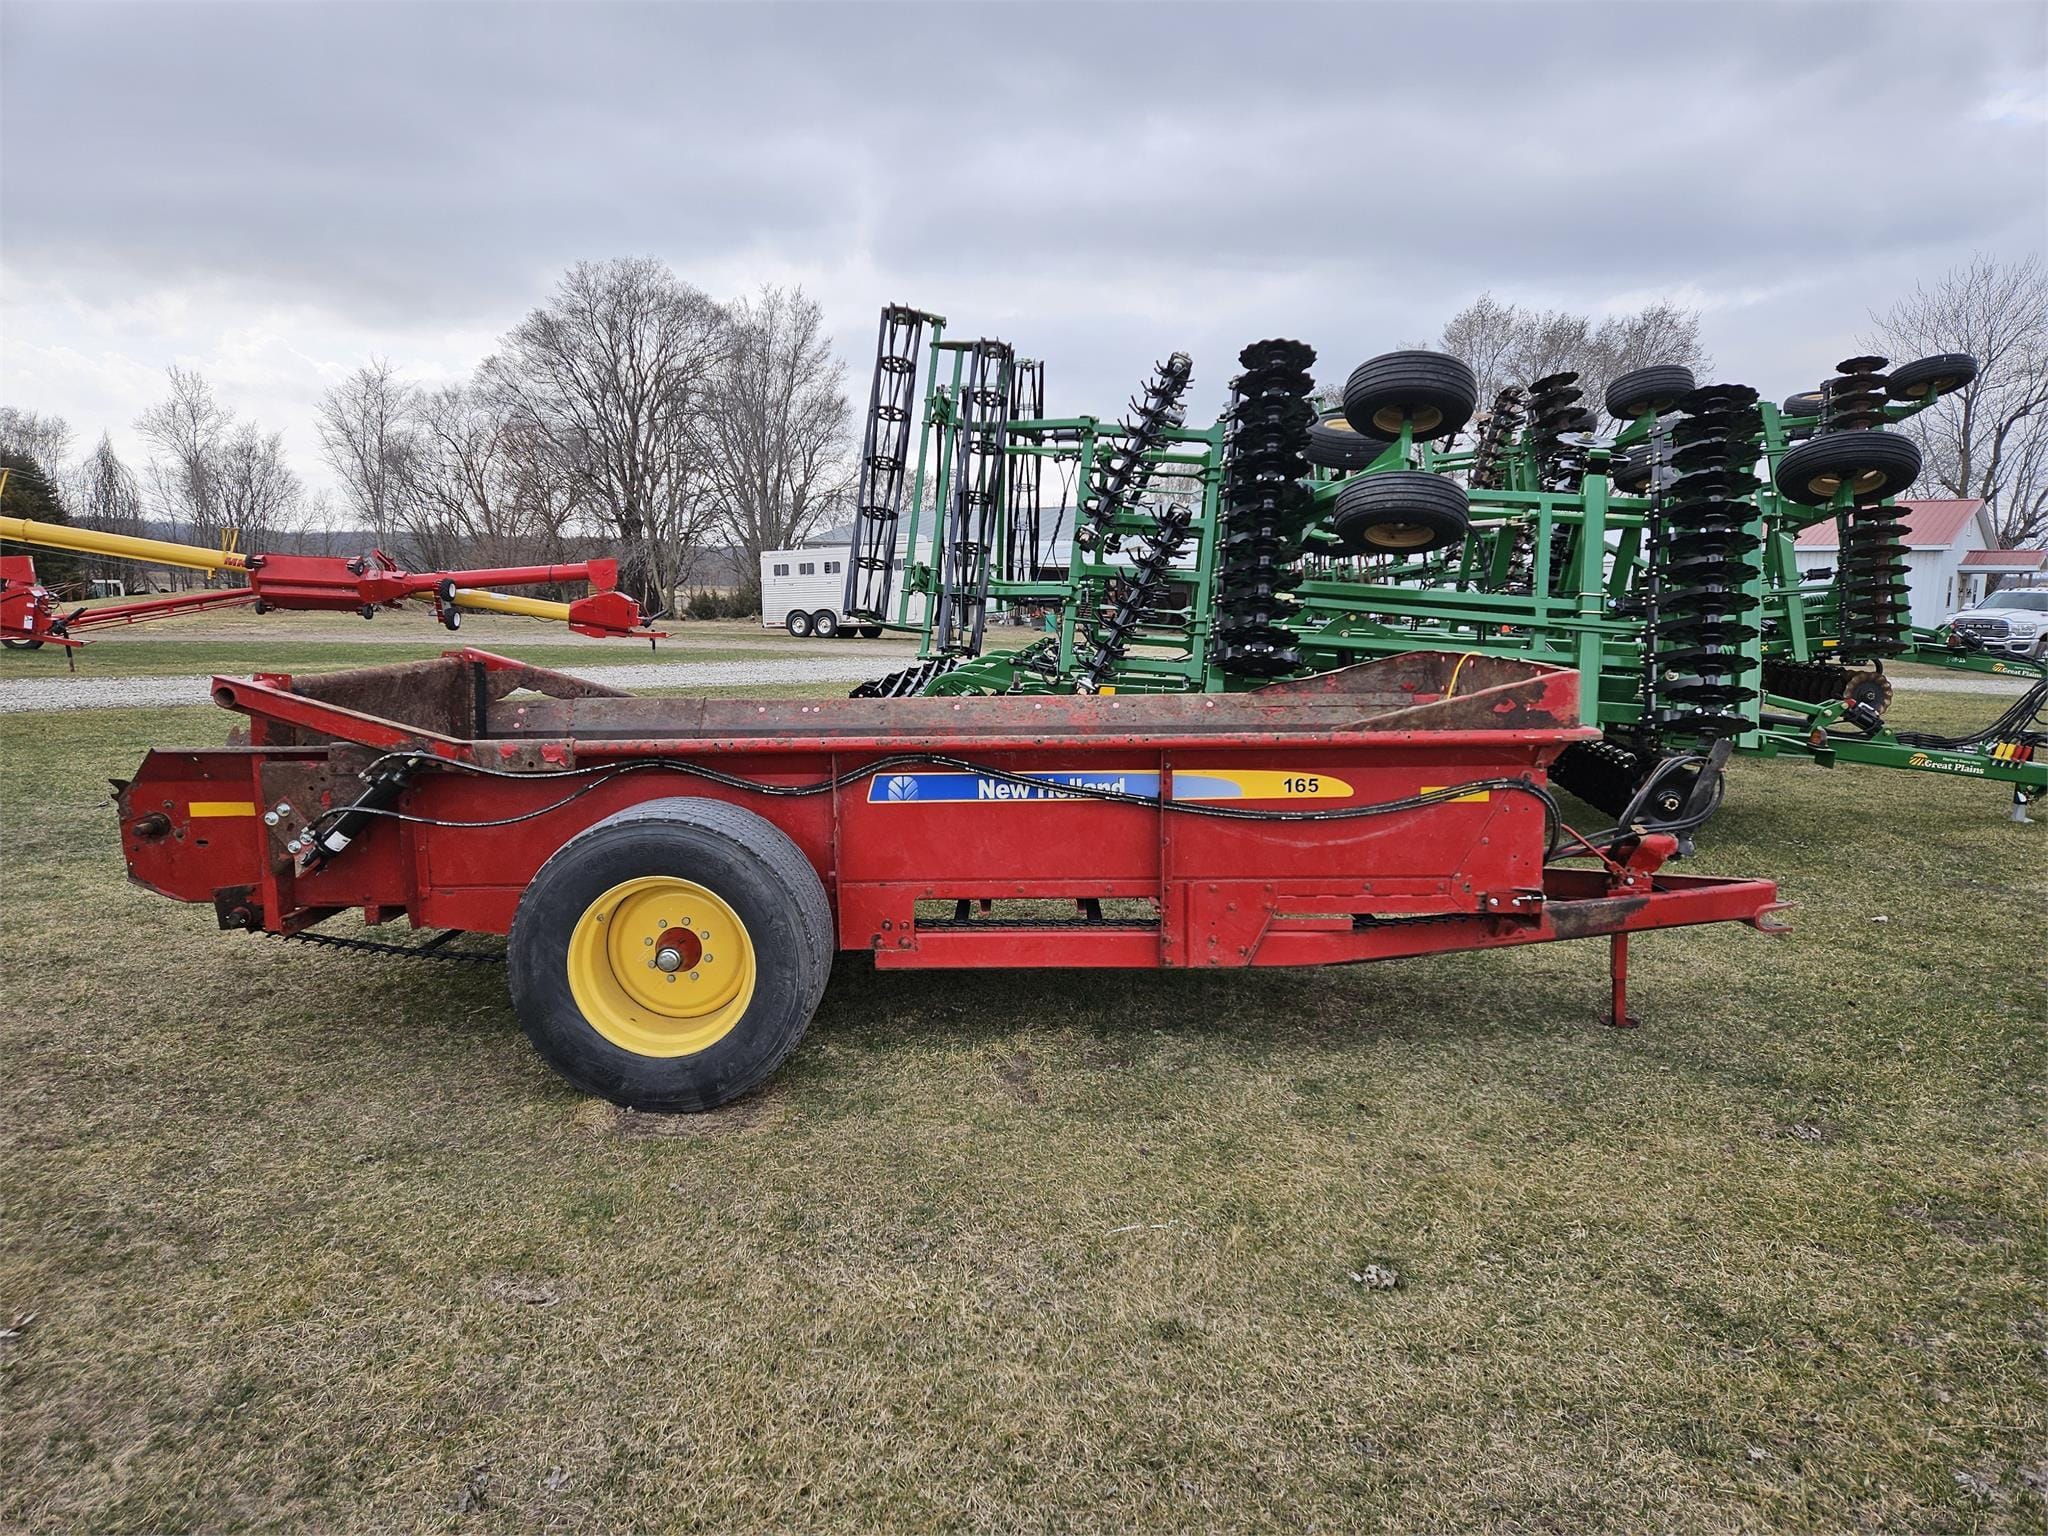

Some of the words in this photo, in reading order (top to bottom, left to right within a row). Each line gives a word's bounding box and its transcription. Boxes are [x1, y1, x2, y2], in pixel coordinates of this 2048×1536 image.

[2003, 667, 2021, 675] Great
[2022, 670, 2042, 678] Plains
[1924, 759, 1952, 770] Great
[1954, 763, 1985, 774] Plains
[978, 779, 1030, 799] New
[1284, 778, 1319, 793] 165
